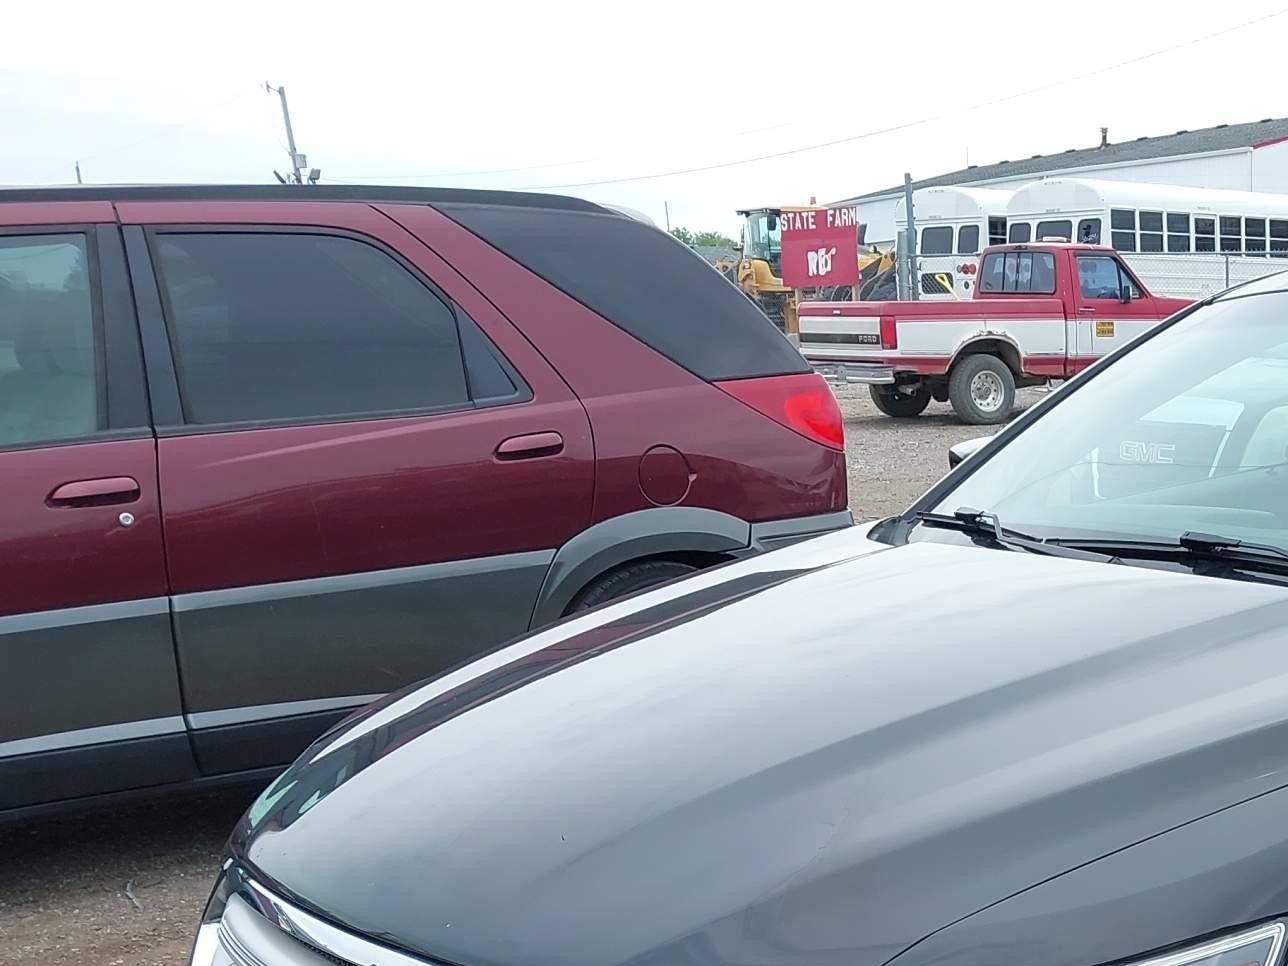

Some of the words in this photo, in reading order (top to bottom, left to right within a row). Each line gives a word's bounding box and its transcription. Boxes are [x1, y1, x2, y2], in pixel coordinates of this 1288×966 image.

[781, 211, 817, 231] STATE
[826, 206, 857, 228] FARM
[858, 335, 877, 343] FORD
[1119, 440, 1176, 464] GMC
